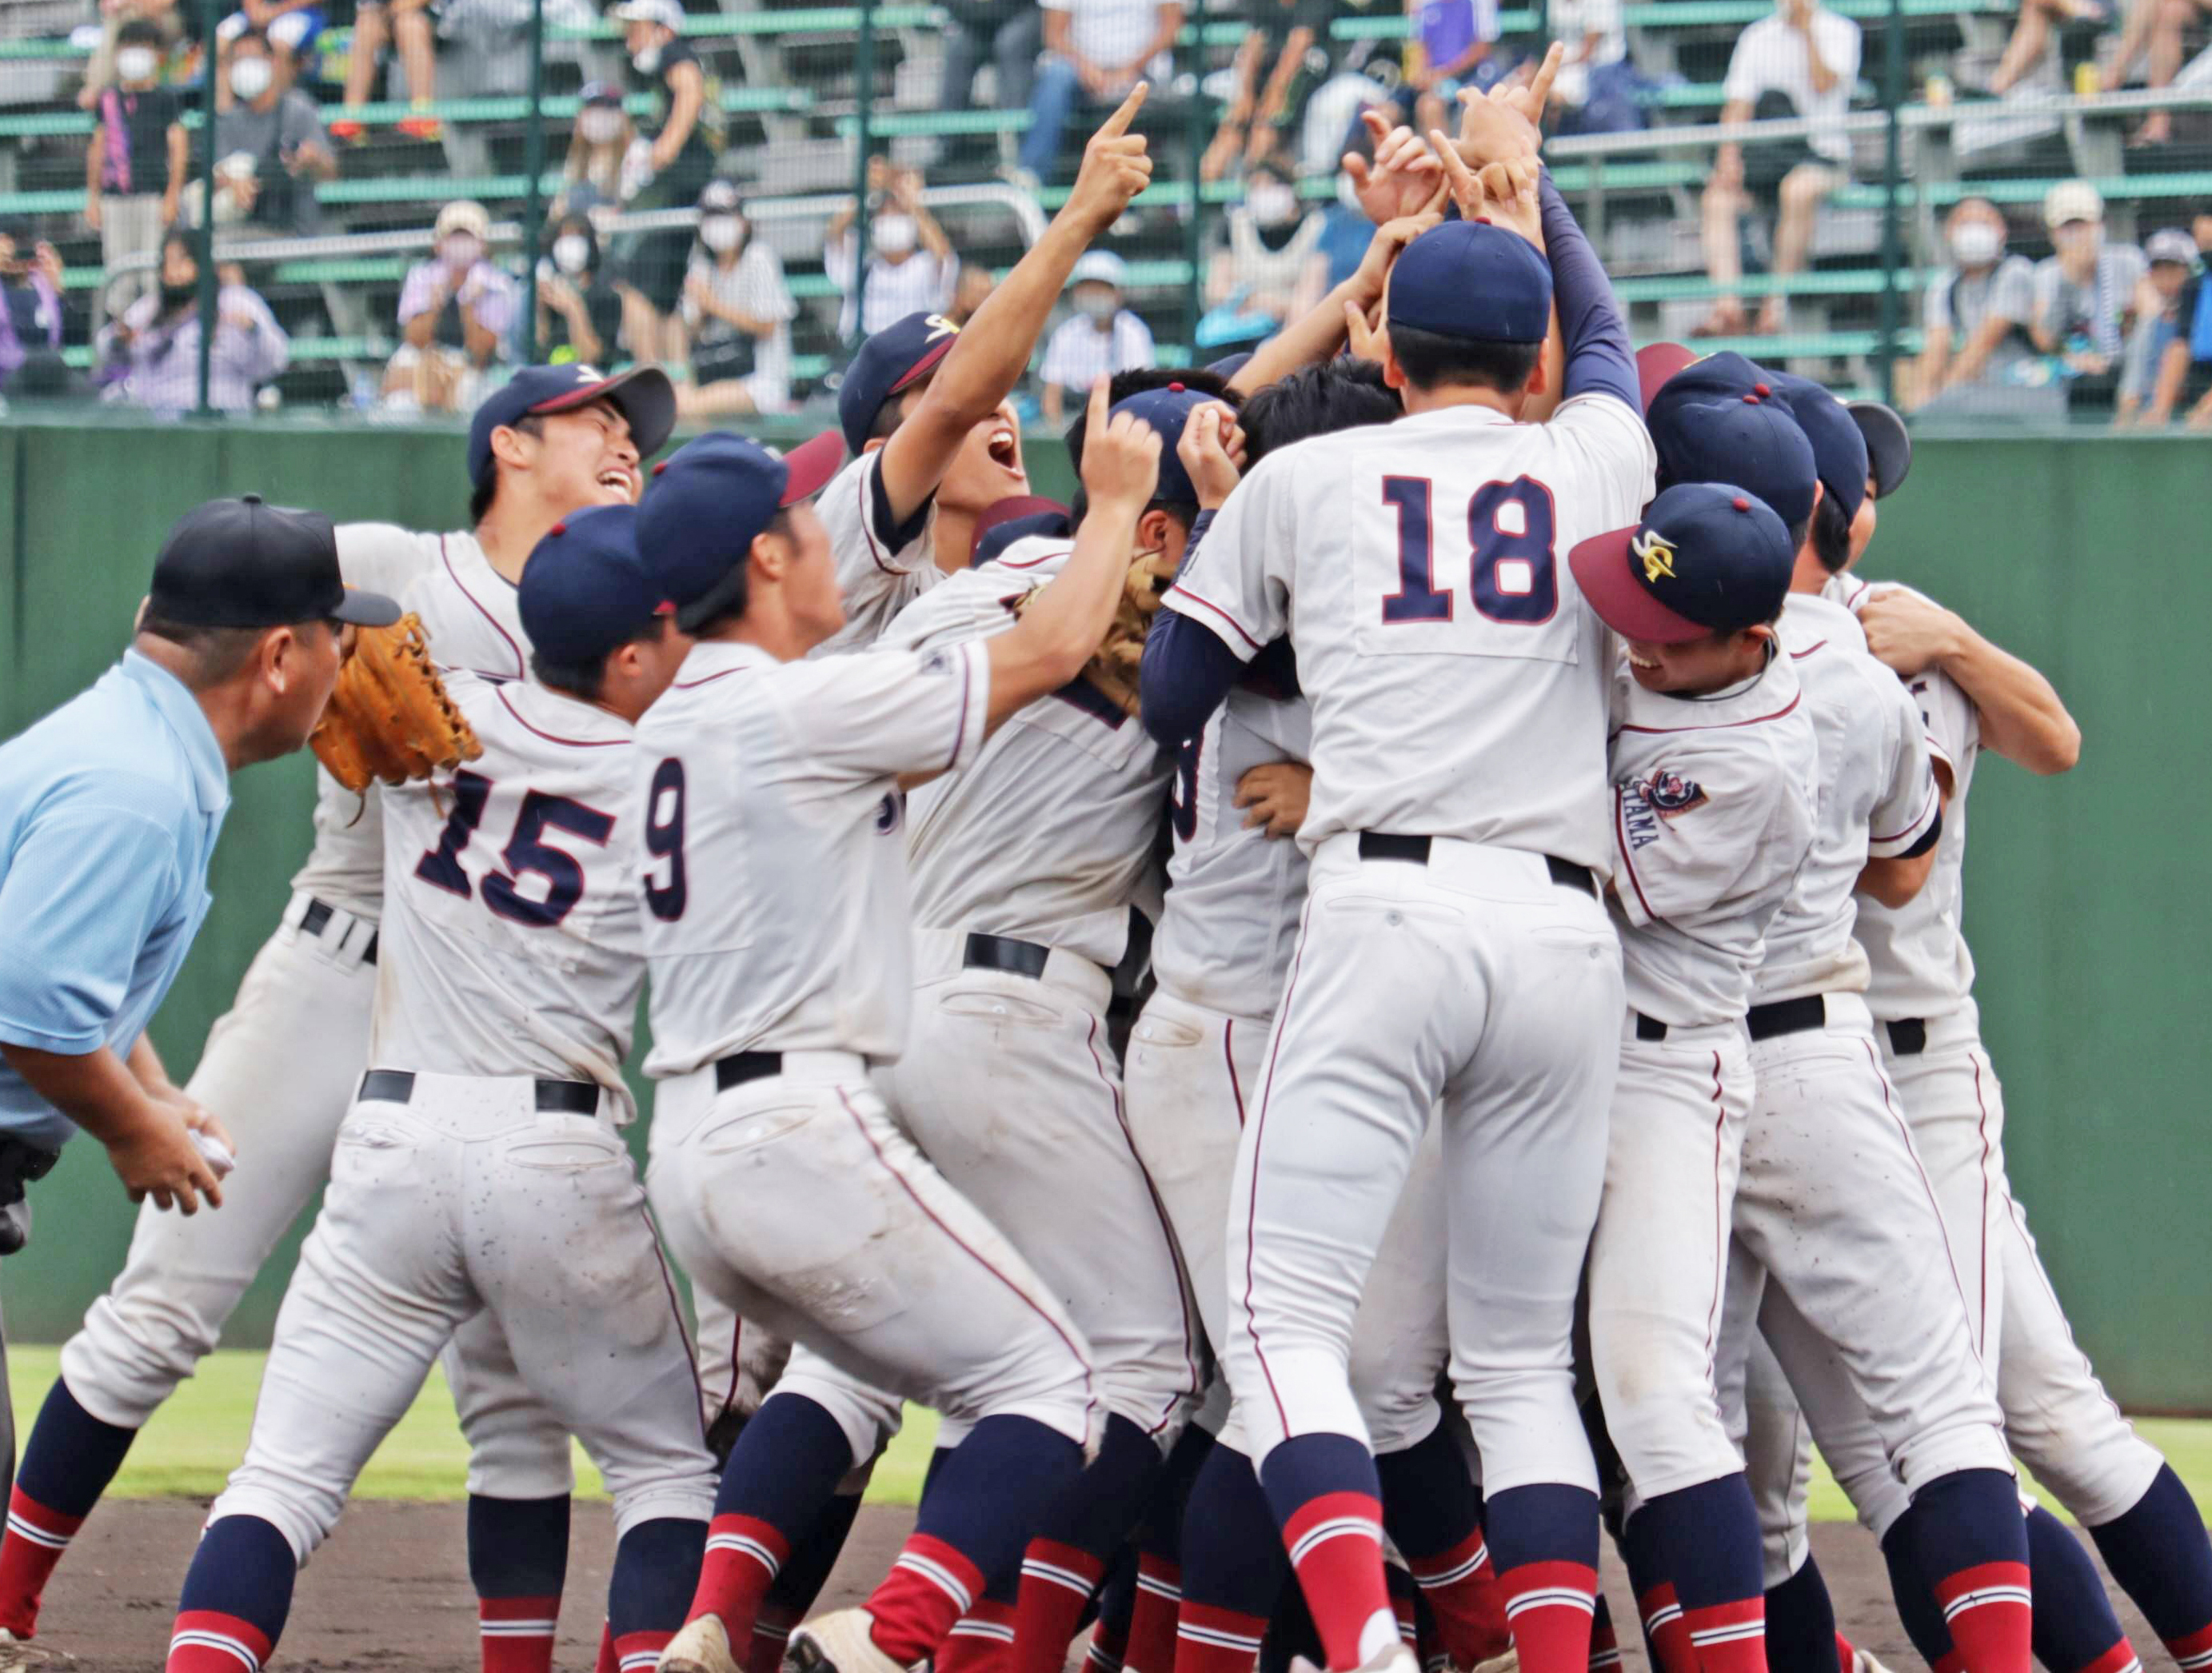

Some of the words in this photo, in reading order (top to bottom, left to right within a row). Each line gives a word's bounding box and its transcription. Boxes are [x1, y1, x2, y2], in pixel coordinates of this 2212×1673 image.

[1382, 473, 1558, 627] 18
[413, 768, 617, 928] 15
[643, 757, 686, 922] 9
